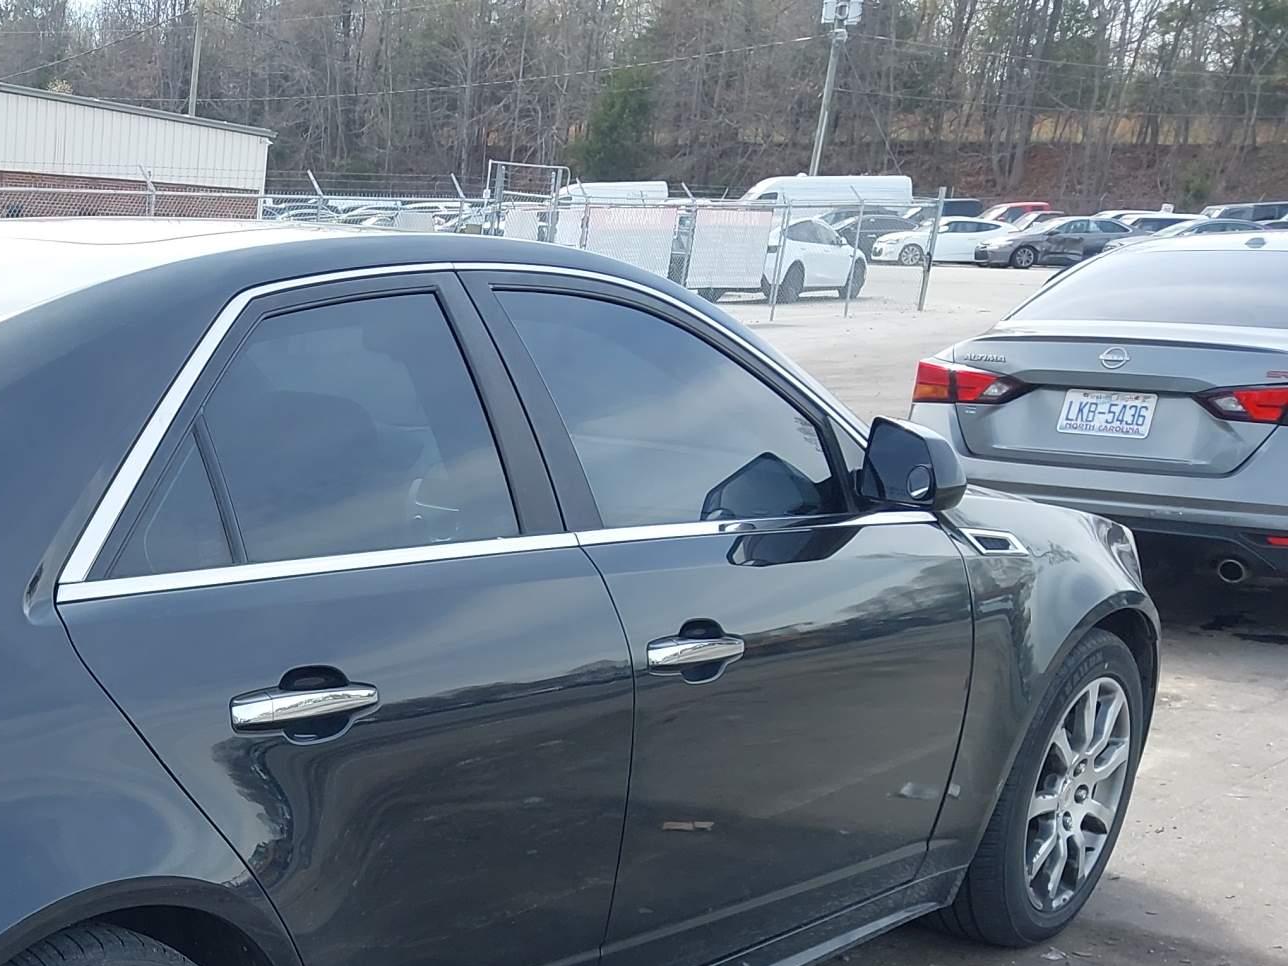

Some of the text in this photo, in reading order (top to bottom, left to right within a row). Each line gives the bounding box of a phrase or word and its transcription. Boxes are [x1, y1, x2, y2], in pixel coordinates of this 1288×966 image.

[1065, 401, 1149, 427] LKB-5436
[1065, 422, 1140, 434] NORTH CAROLINA
